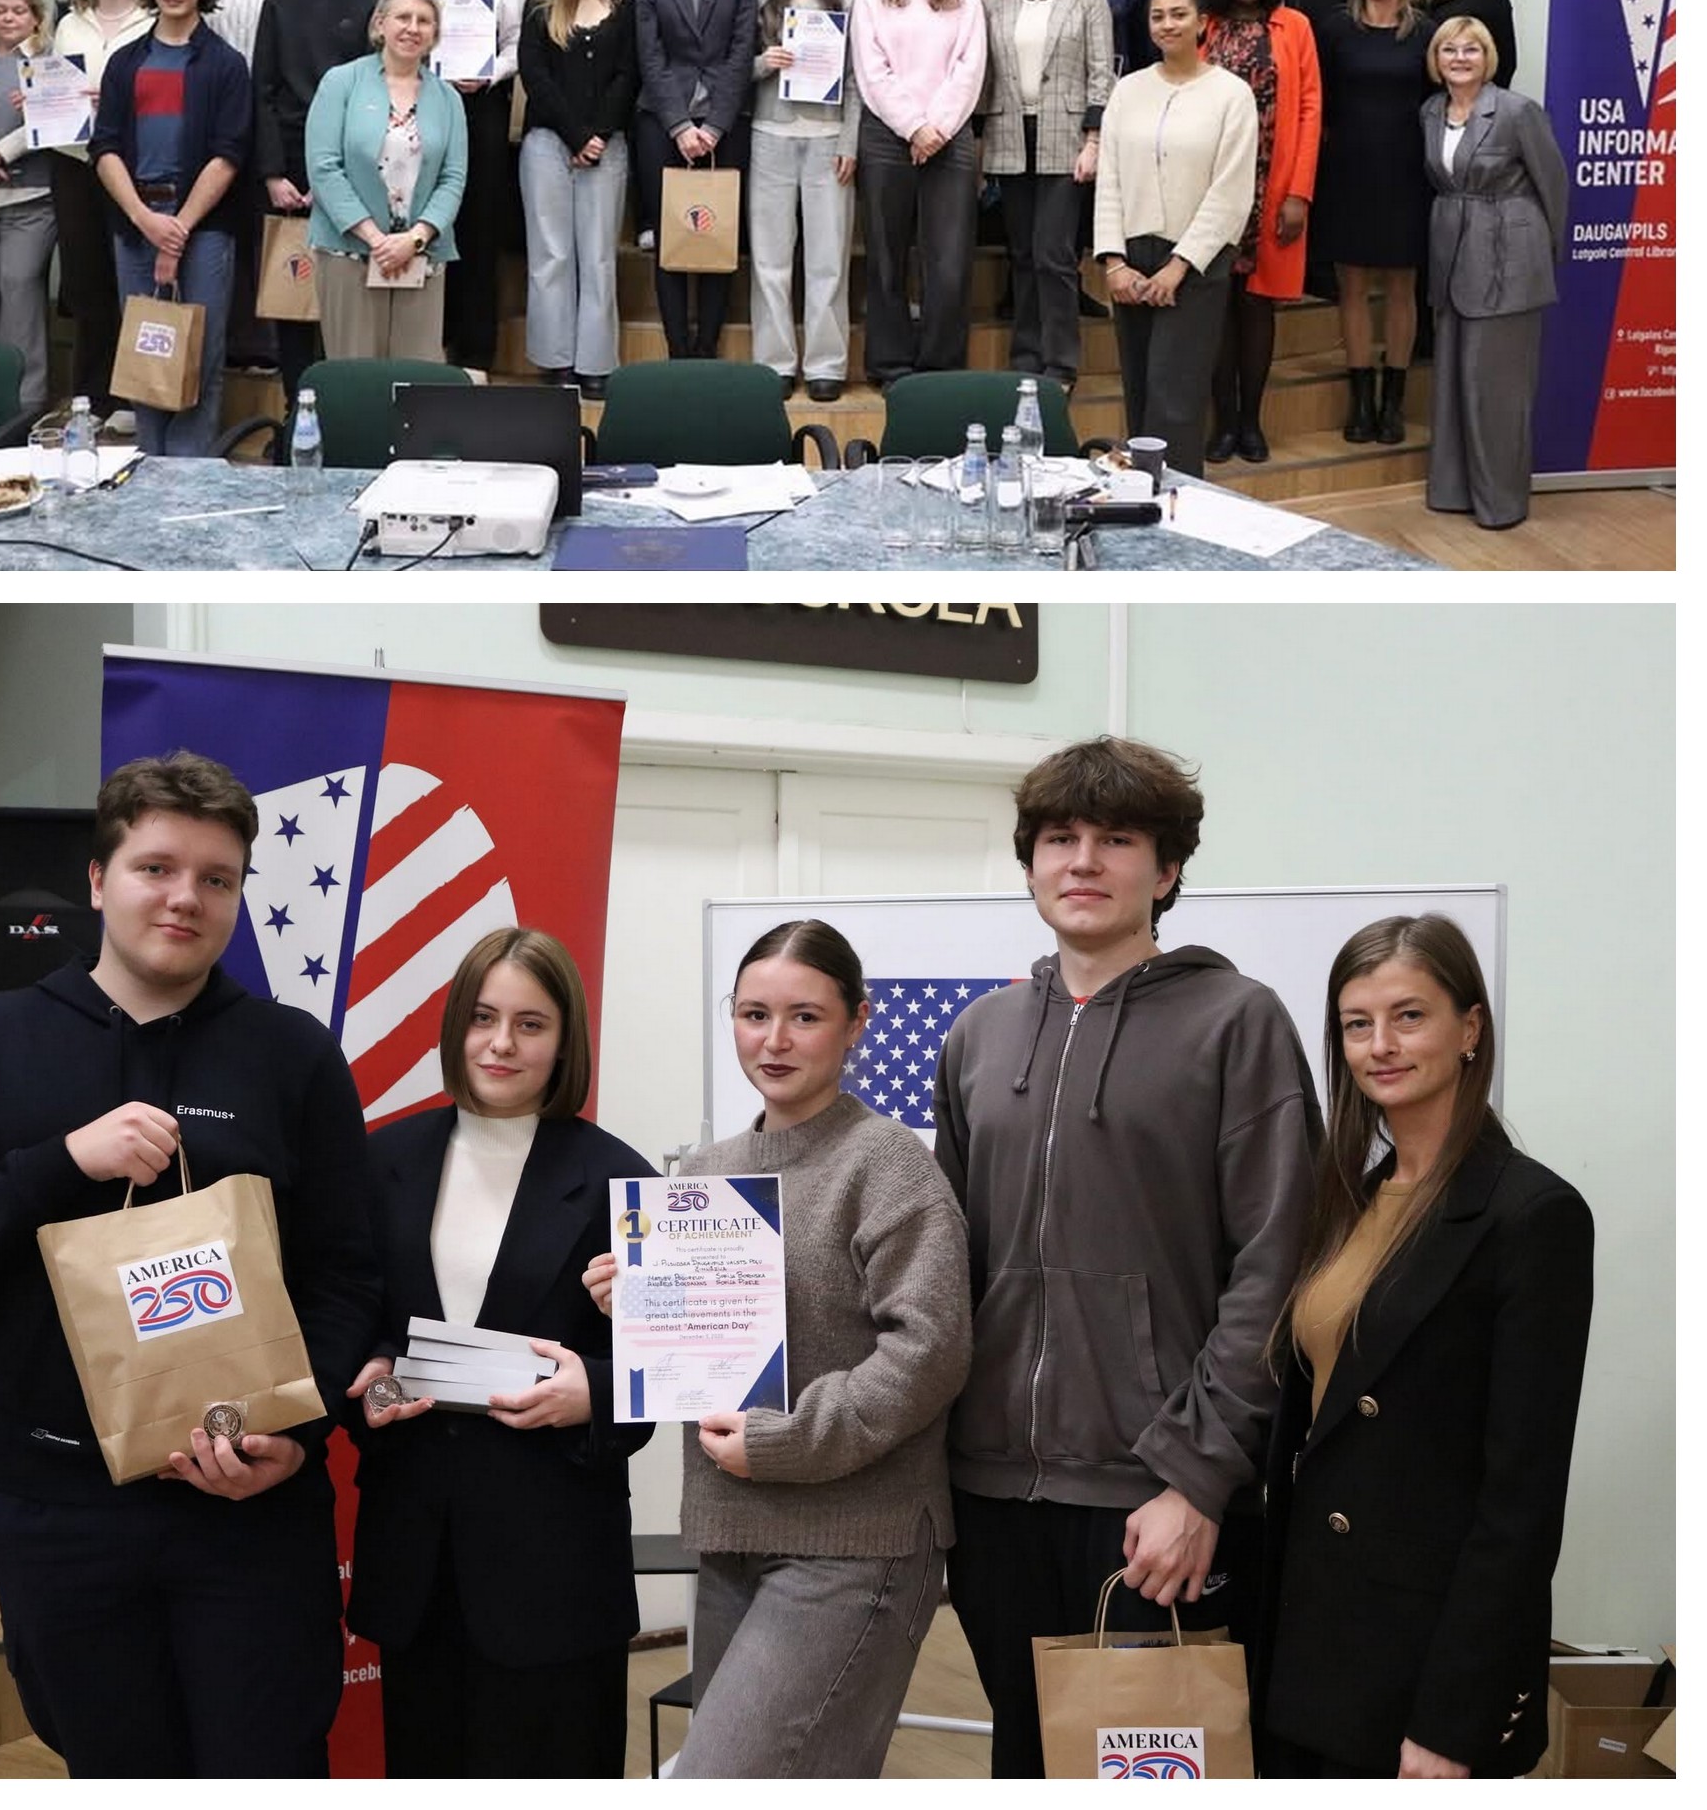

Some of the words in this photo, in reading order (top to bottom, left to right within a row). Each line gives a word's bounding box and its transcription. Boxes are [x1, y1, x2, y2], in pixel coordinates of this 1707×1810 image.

[1580, 99, 1626, 124] USA
[1576, 161, 1665, 187] CENTER
[1574, 223, 1667, 242] DAUGAVPILS
[177, 1105, 235, 1119] Erasmus+
[667, 1191, 710, 1211] 250
[625, 1211, 644, 1238] 1
[657, 1217, 761, 1233] CERTIFICATE
[669, 1232, 681, 1240] OF
[683, 1230, 752, 1239] ACHIEVEMENT
[127, 1248, 222, 1285] AMERICA
[129, 1269, 232, 1332] 250
[644, 1299, 660, 1307] This
[663, 1298, 707, 1307] certificate
[720, 1298, 742, 1307] given
[745, 1295, 757, 1304] for
[645, 1312, 669, 1321] great
[672, 1309, 731, 1319] achievements
[684, 1322, 729, 1330] "American
[732, 1321, 752, 1331] Day"
[1102, 1733, 1198, 1749] AMERICA
